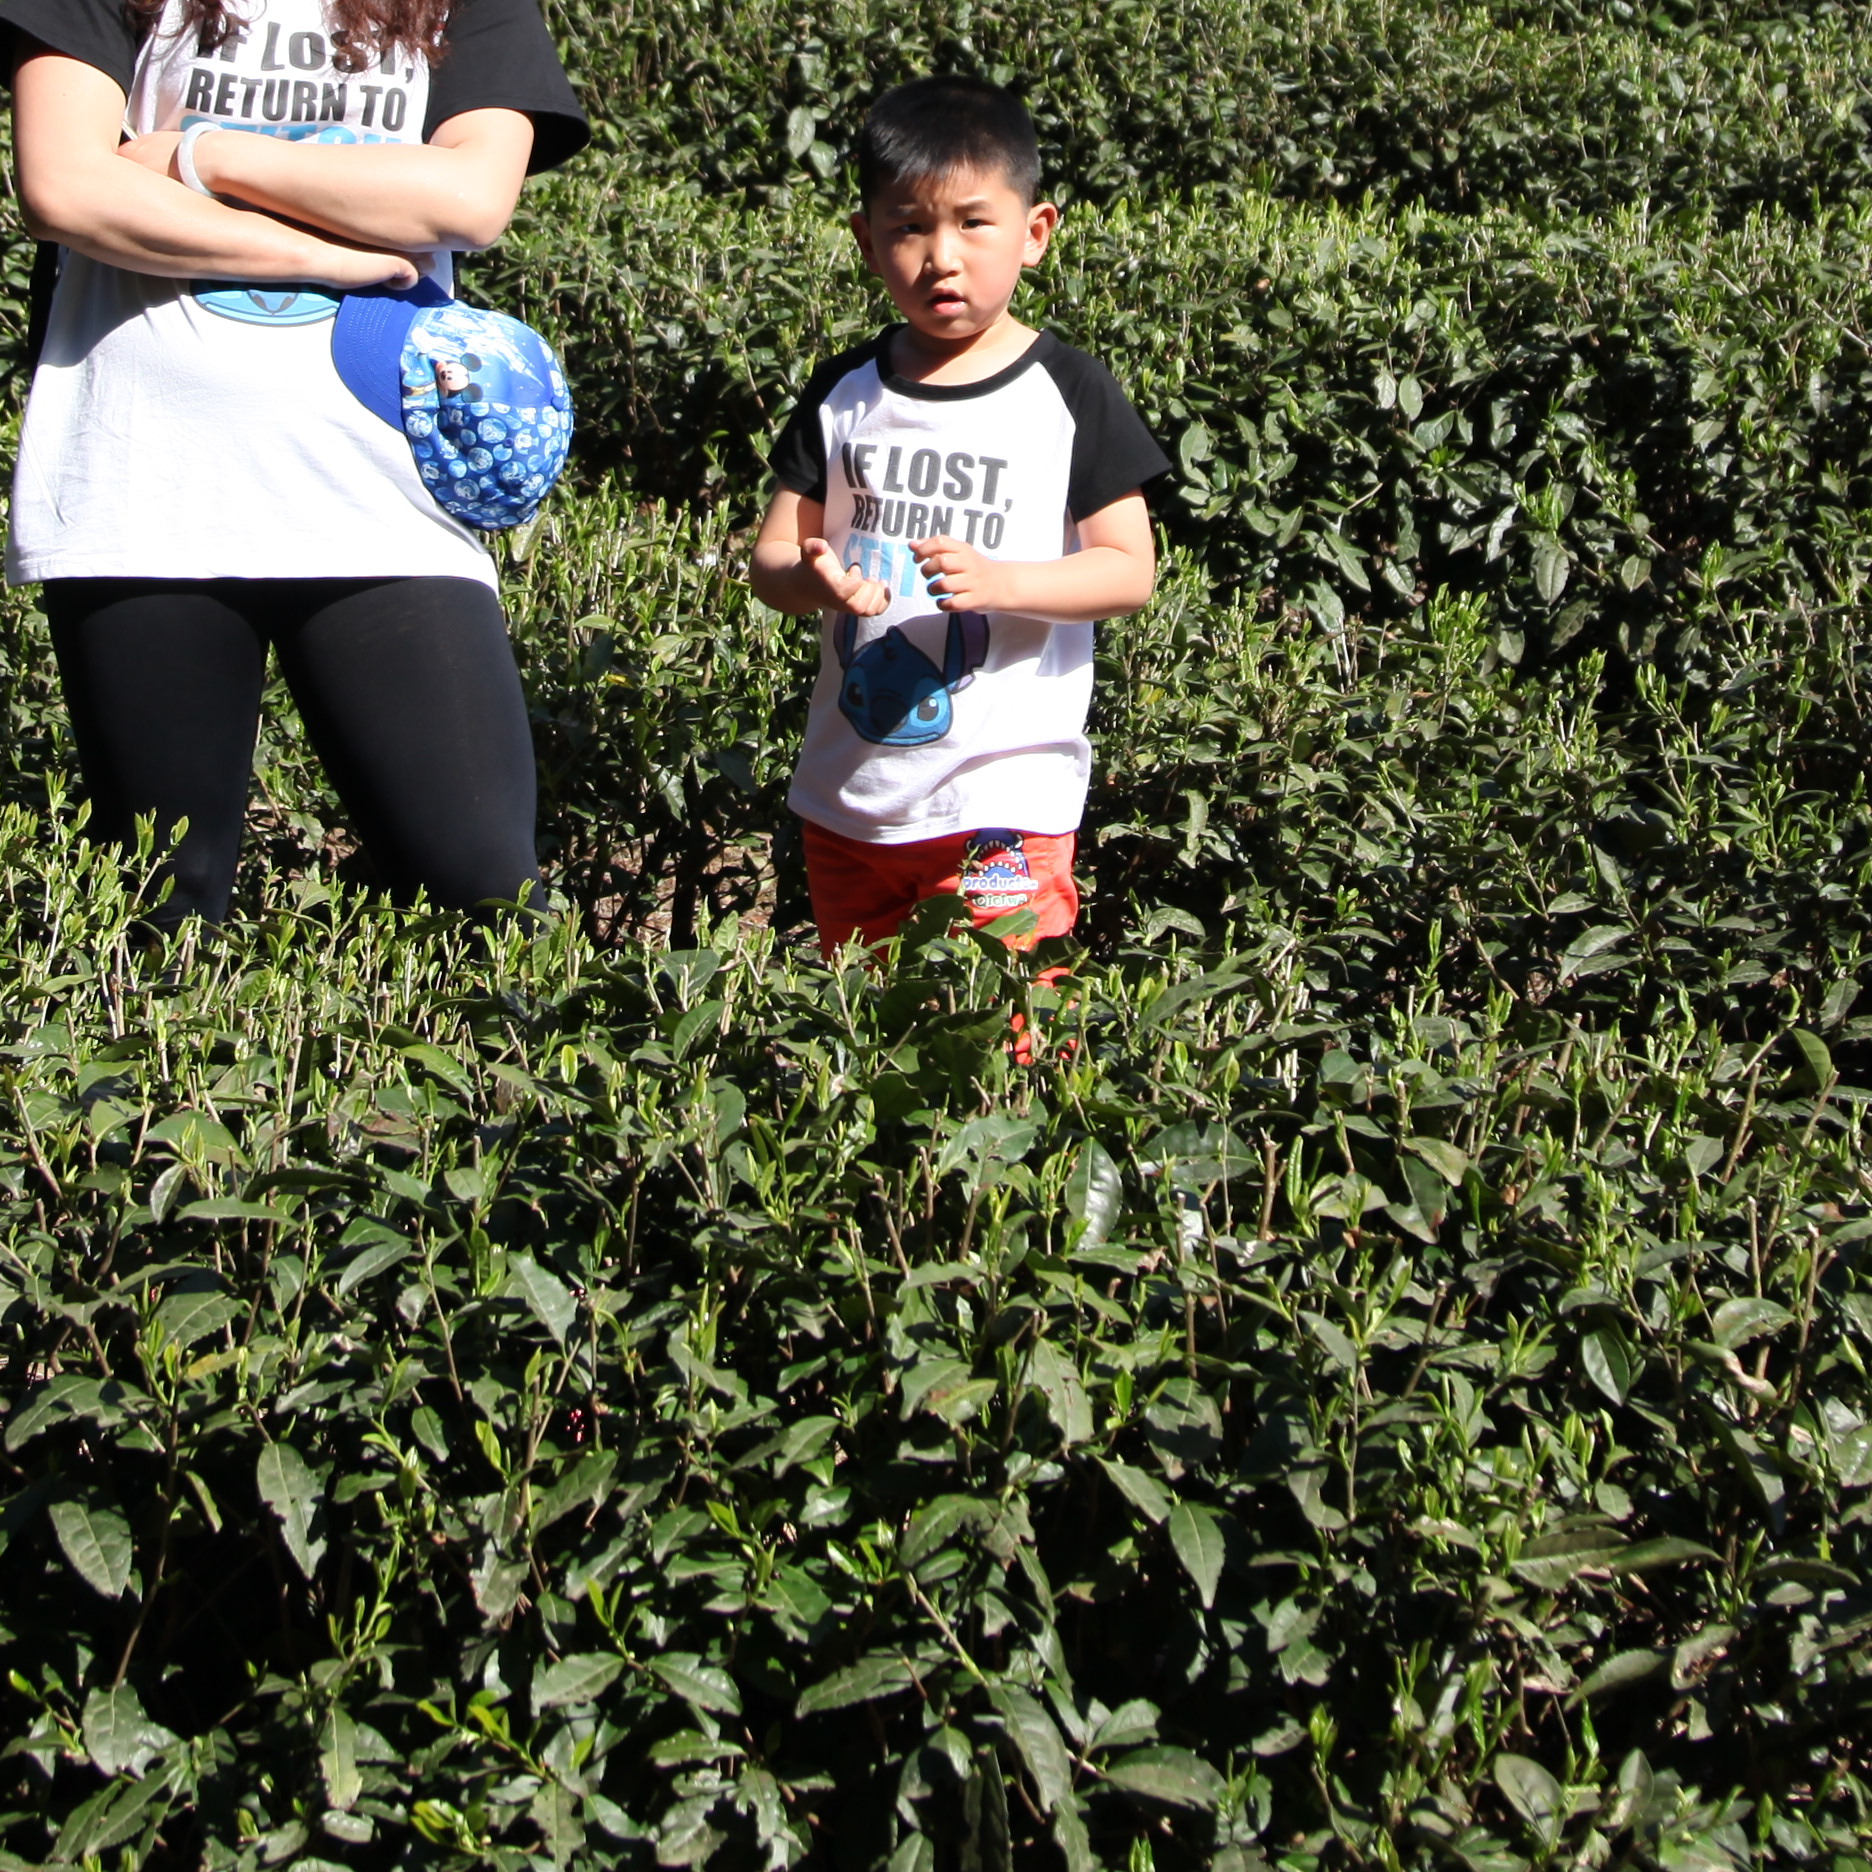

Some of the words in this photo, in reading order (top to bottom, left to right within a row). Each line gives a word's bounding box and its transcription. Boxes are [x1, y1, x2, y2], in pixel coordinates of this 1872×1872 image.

[185, 67, 348, 122] RETURN
[360, 84, 408, 132] TO
[841, 442, 878, 489] IF
[882, 445, 1014, 513] LOST,
[850, 493, 954, 540] RETURN
[964, 508, 1006, 550] TO
[843, 532, 958, 608] TIT
